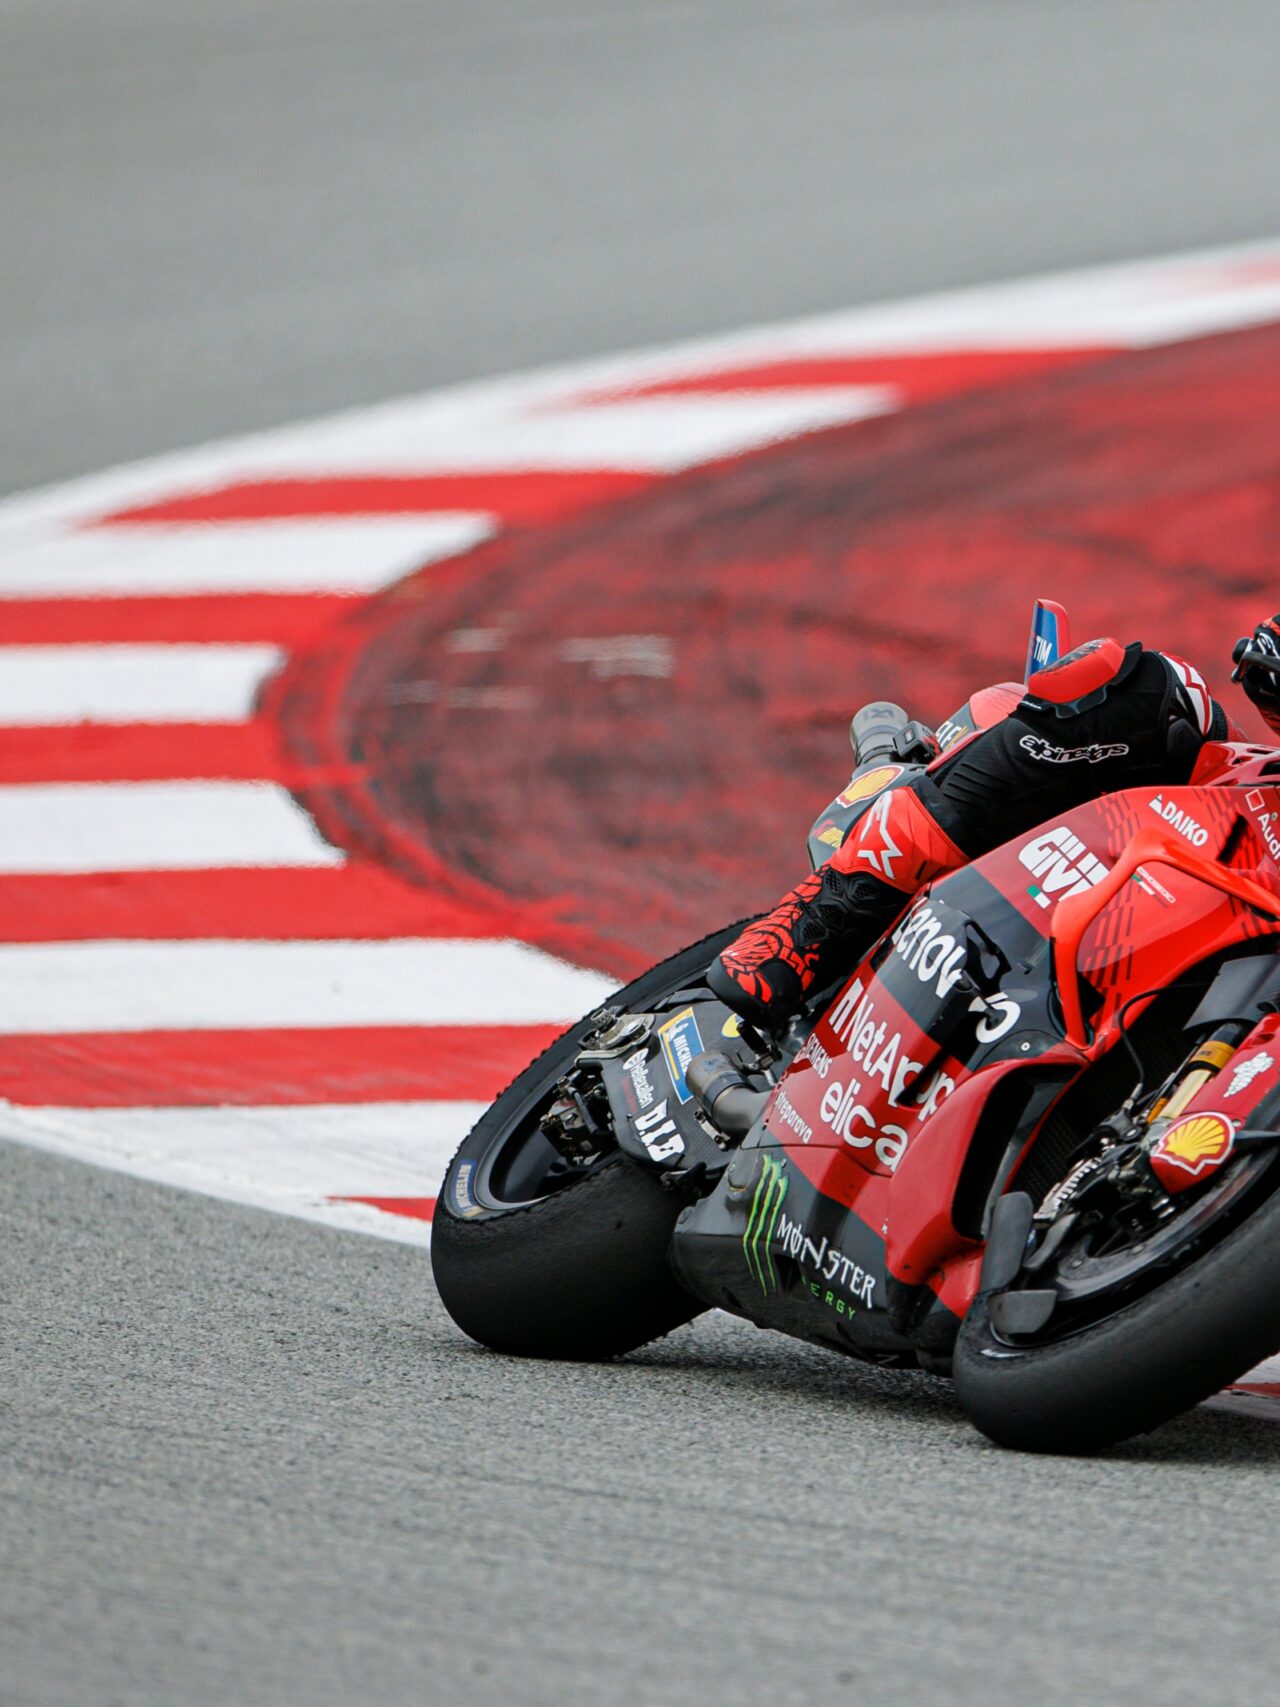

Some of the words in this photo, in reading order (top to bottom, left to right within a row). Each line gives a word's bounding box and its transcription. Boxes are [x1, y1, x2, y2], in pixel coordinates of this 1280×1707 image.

[1033, 635, 1053, 666] TIM
[1161, 800, 1209, 847] DAIKO
[672, 1034, 692, 1077] MICHE
[806, 1032, 833, 1079] SIEMENS
[839, 993, 956, 1123] NetApp
[819, 1077, 909, 1173] elica
[776, 1212, 877, 1310] MONSTER
[801, 1275, 857, 1320] ERGY
